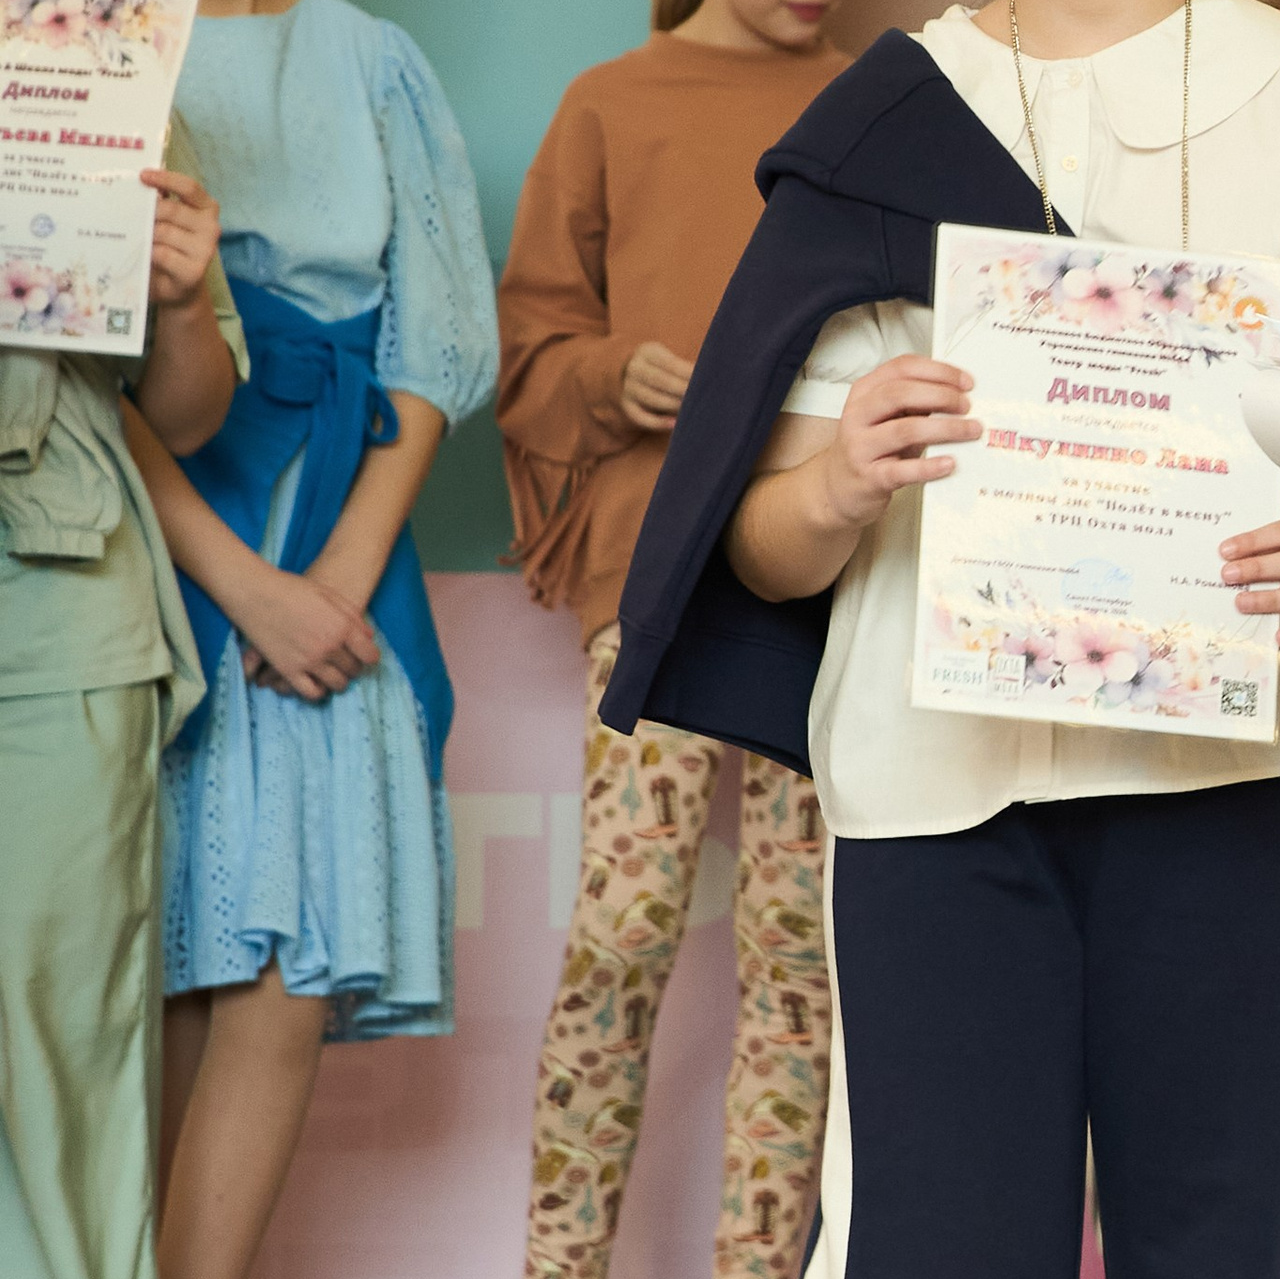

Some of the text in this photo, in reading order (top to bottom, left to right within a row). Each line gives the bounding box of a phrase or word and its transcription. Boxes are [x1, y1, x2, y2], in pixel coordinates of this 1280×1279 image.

[1, 81, 90, 101] Диплом
[0, 127, 144, 150] ьева Милана
[1047, 377, 1171, 412] Диплом
[1155, 447, 1230, 475] Лана
